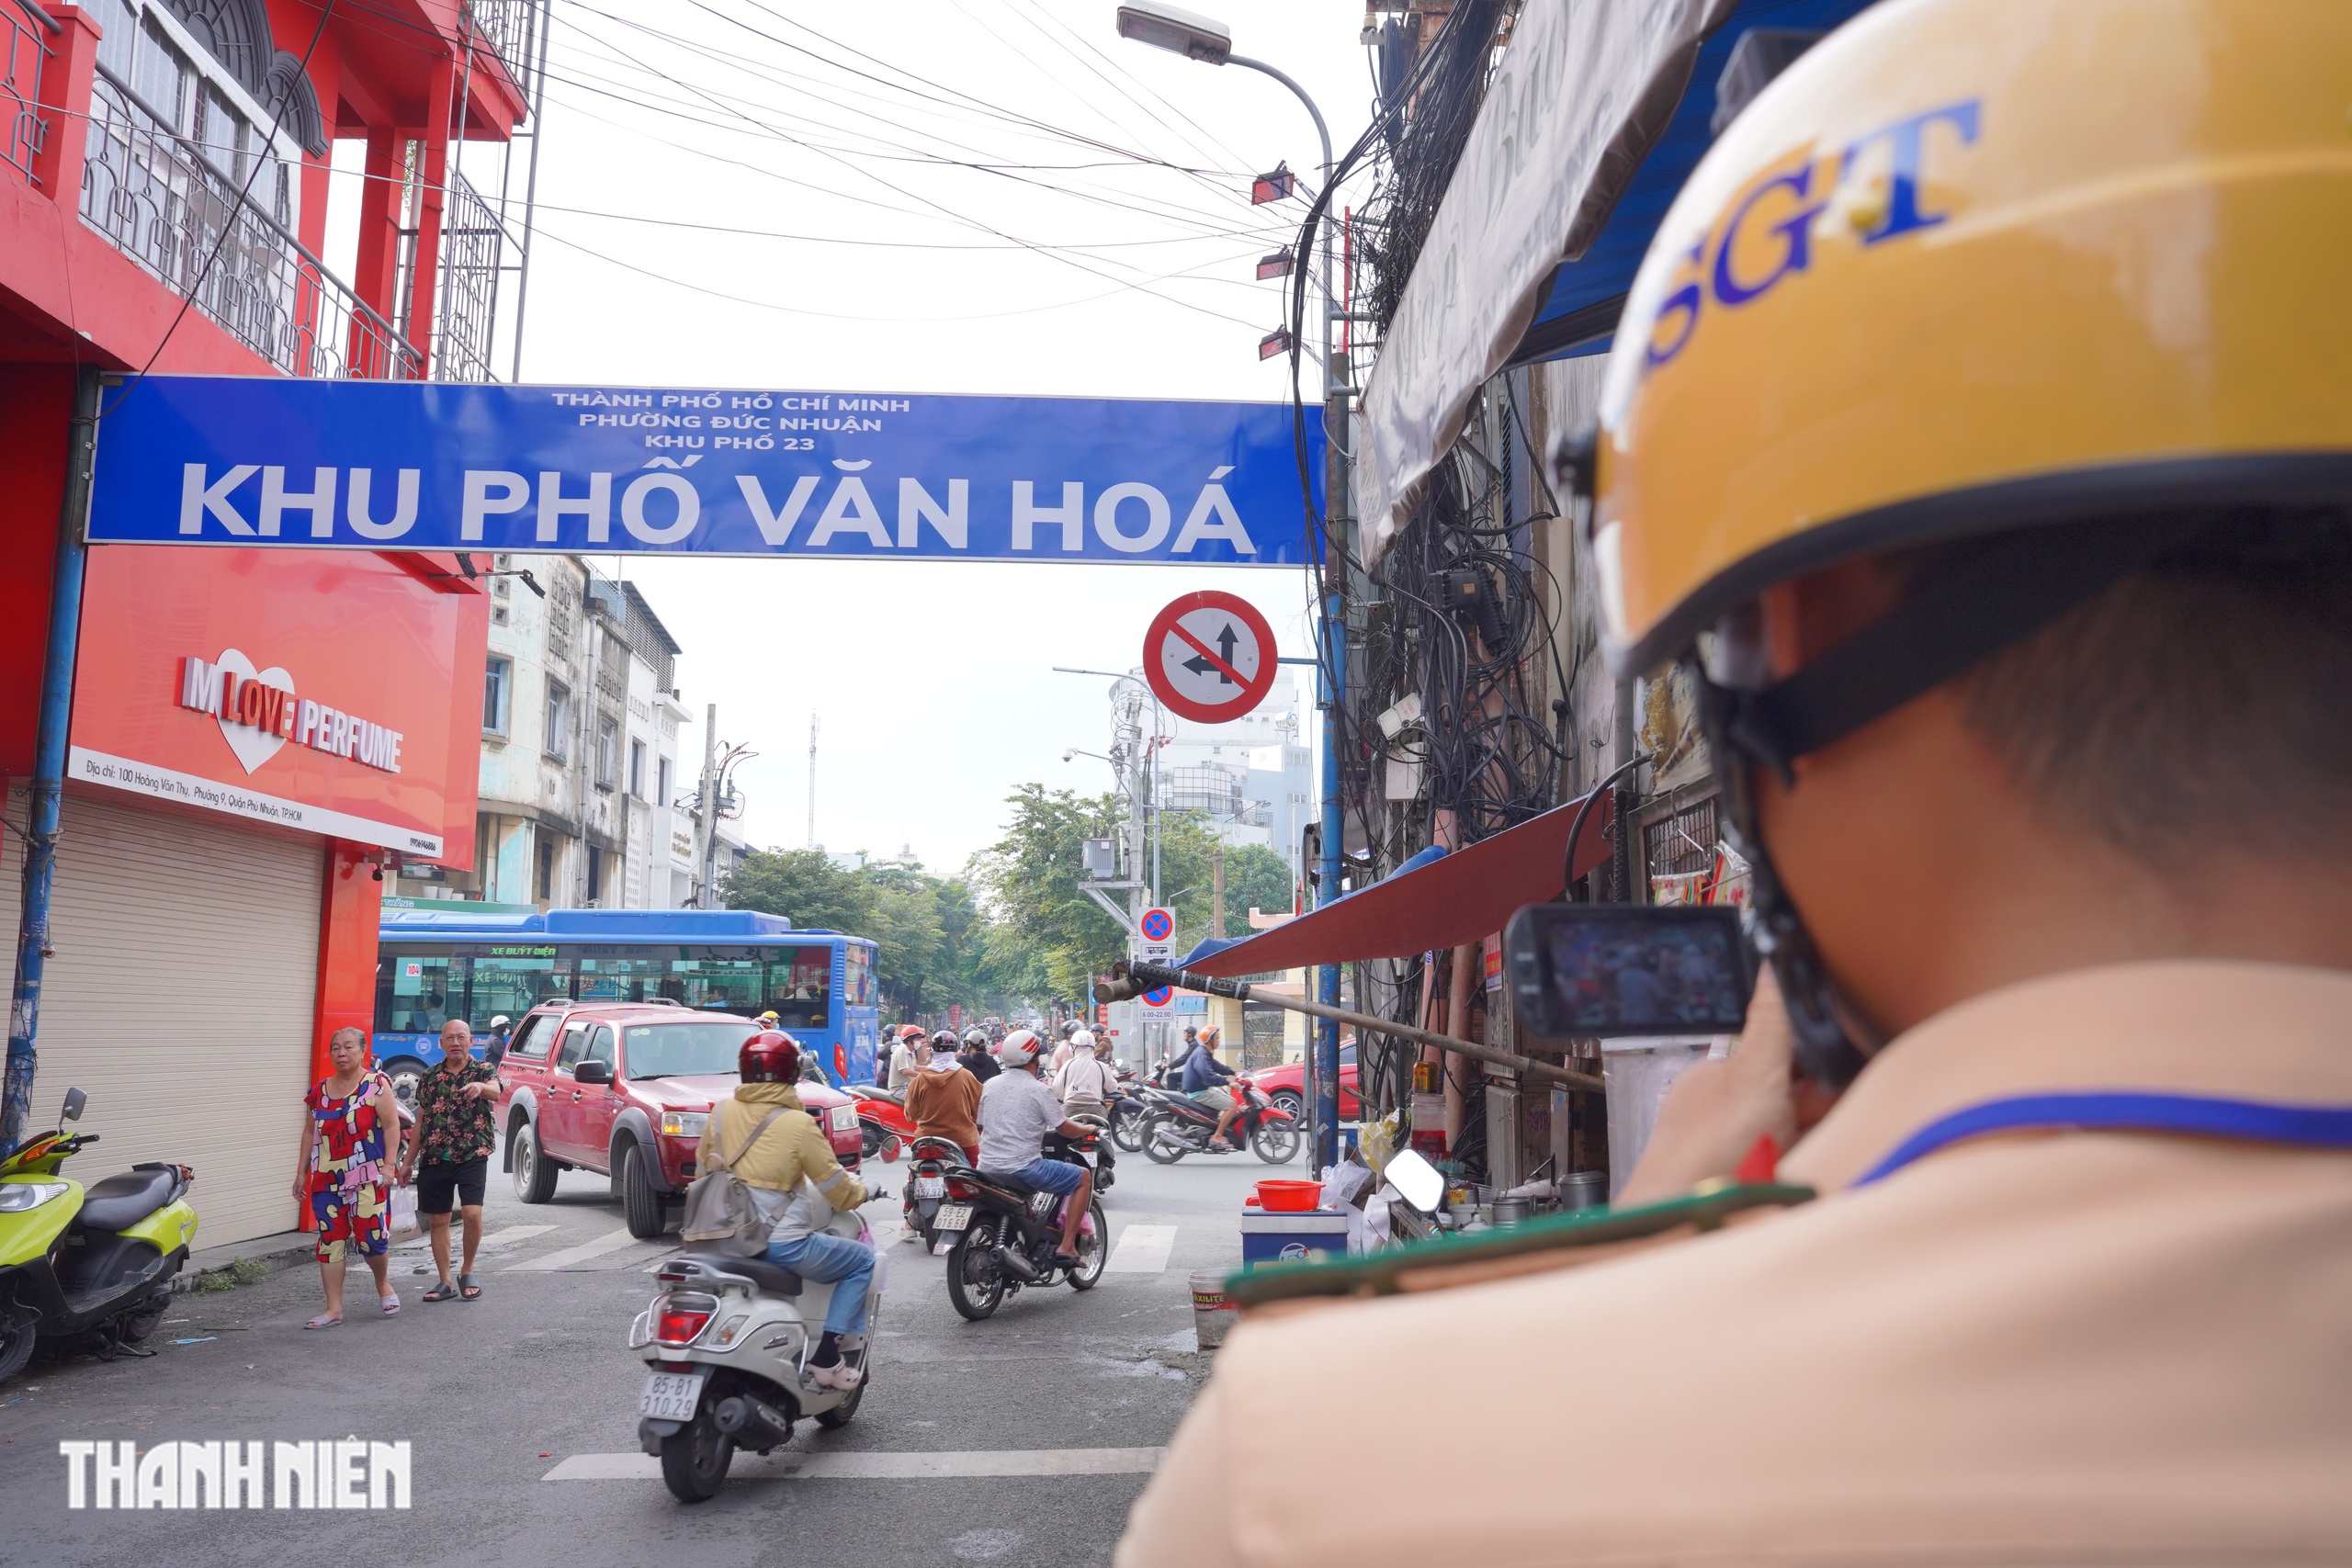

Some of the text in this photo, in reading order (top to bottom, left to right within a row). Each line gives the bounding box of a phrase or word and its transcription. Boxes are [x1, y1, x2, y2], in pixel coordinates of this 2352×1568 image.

[551, 390, 910, 412] THÀNH PHỐ HỒ CHÍ MINH
[579, 411, 882, 434] PHƯỜNG ĐỨC NHUẬN
[645, 433, 815, 451] KHU PHỐ 23
[178, 454, 1258, 555] KHU PHỐ VĂN HOÁ
[220, 671, 295, 739] LOVE
[295, 698, 403, 773] PERFUME
[85, 759, 100, 776] Địa
[102, 764, 116, 779] chỉ:
[119, 767, 133, 783] 100
[134, 771, 160, 792] Hoàng
[160, 777, 175, 792] Văn
[175, 781, 190, 797] Thụ,
[220, 793, 227, 806] 9,
[228, 794, 246, 810] Quận
[246, 798, 259, 812] Phú
[259, 801, 279, 818] Nhuận,
[281, 807, 302, 822] TP.HCM
[491, 947, 504, 955] XE
[506, 945, 533, 955] BUÝT
[408, 964, 420, 975] 104
[936, 1217, 967, 1229] 016.68
[943, 1207, 967, 1218] 59-E2
[651, 1376, 693, 1397] 85-B1
[641, 1394, 693, 1416] 310.29
